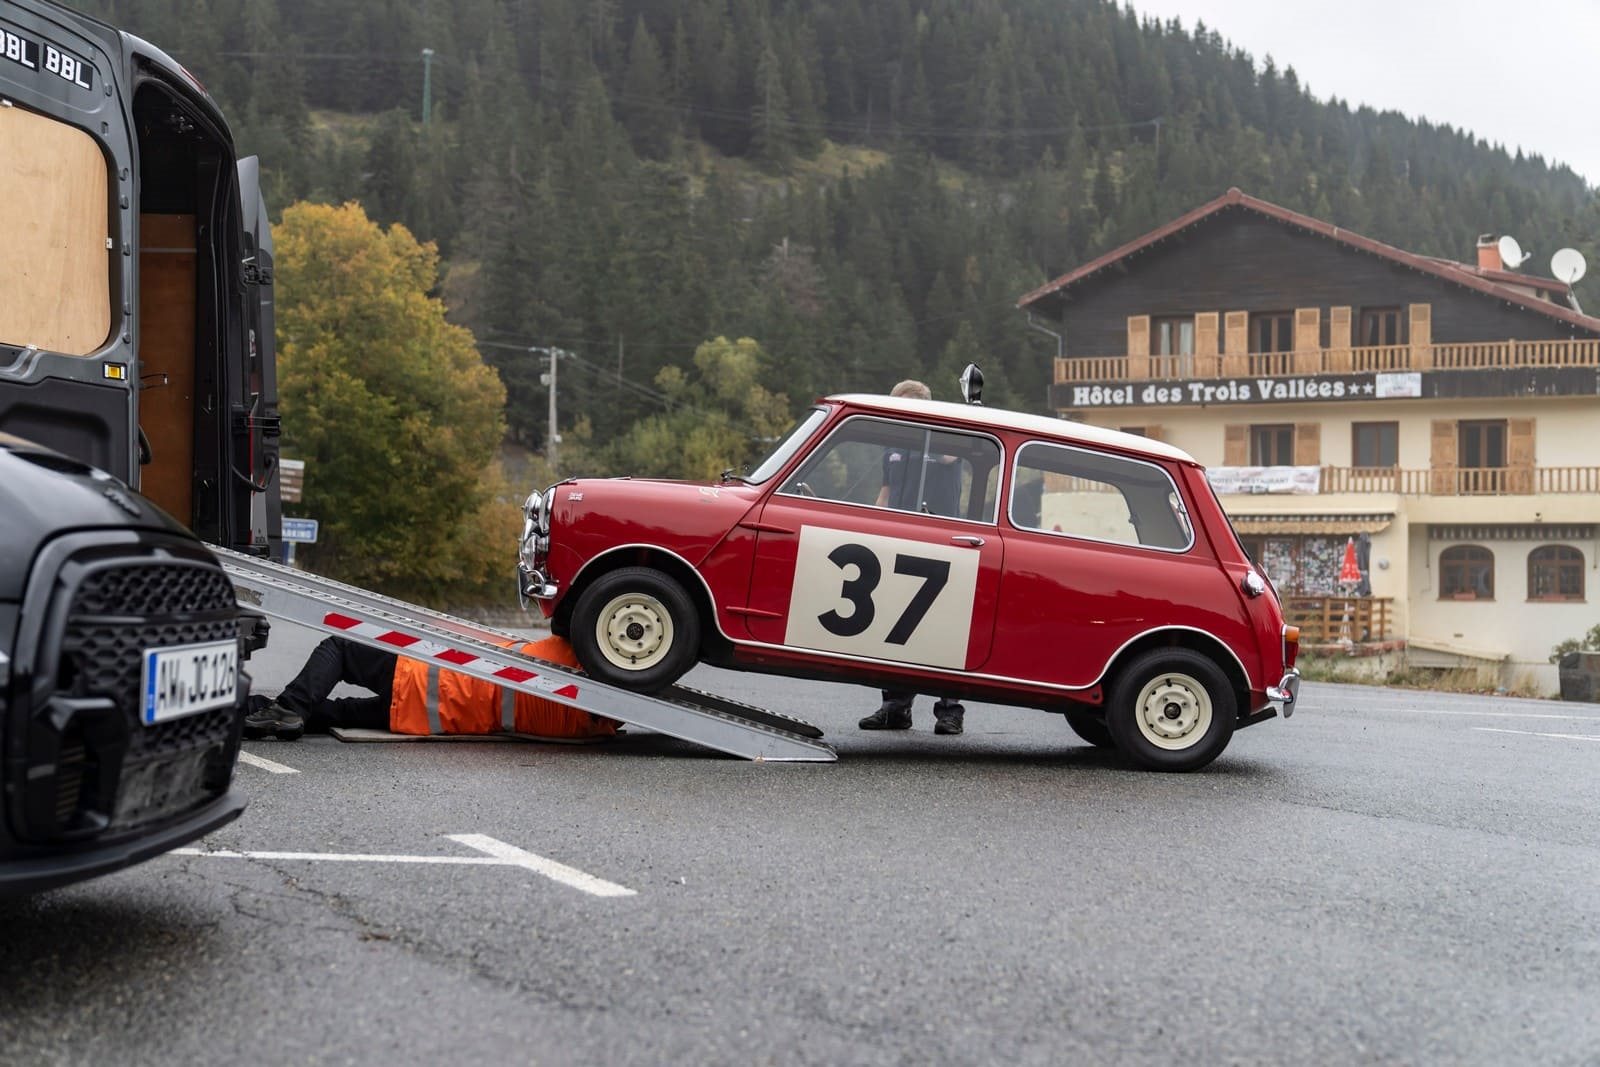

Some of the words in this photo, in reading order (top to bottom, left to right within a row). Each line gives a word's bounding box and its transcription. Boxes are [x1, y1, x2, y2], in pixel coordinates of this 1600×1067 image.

[45, 45, 90, 89] BBL
[1073, 385, 1133, 405] Hôtel
[1142, 384, 1182, 403] des
[1188, 379, 1251, 402] Trois
[1257, 378, 1345, 400] Vallées
[817, 543, 951, 646] 37
